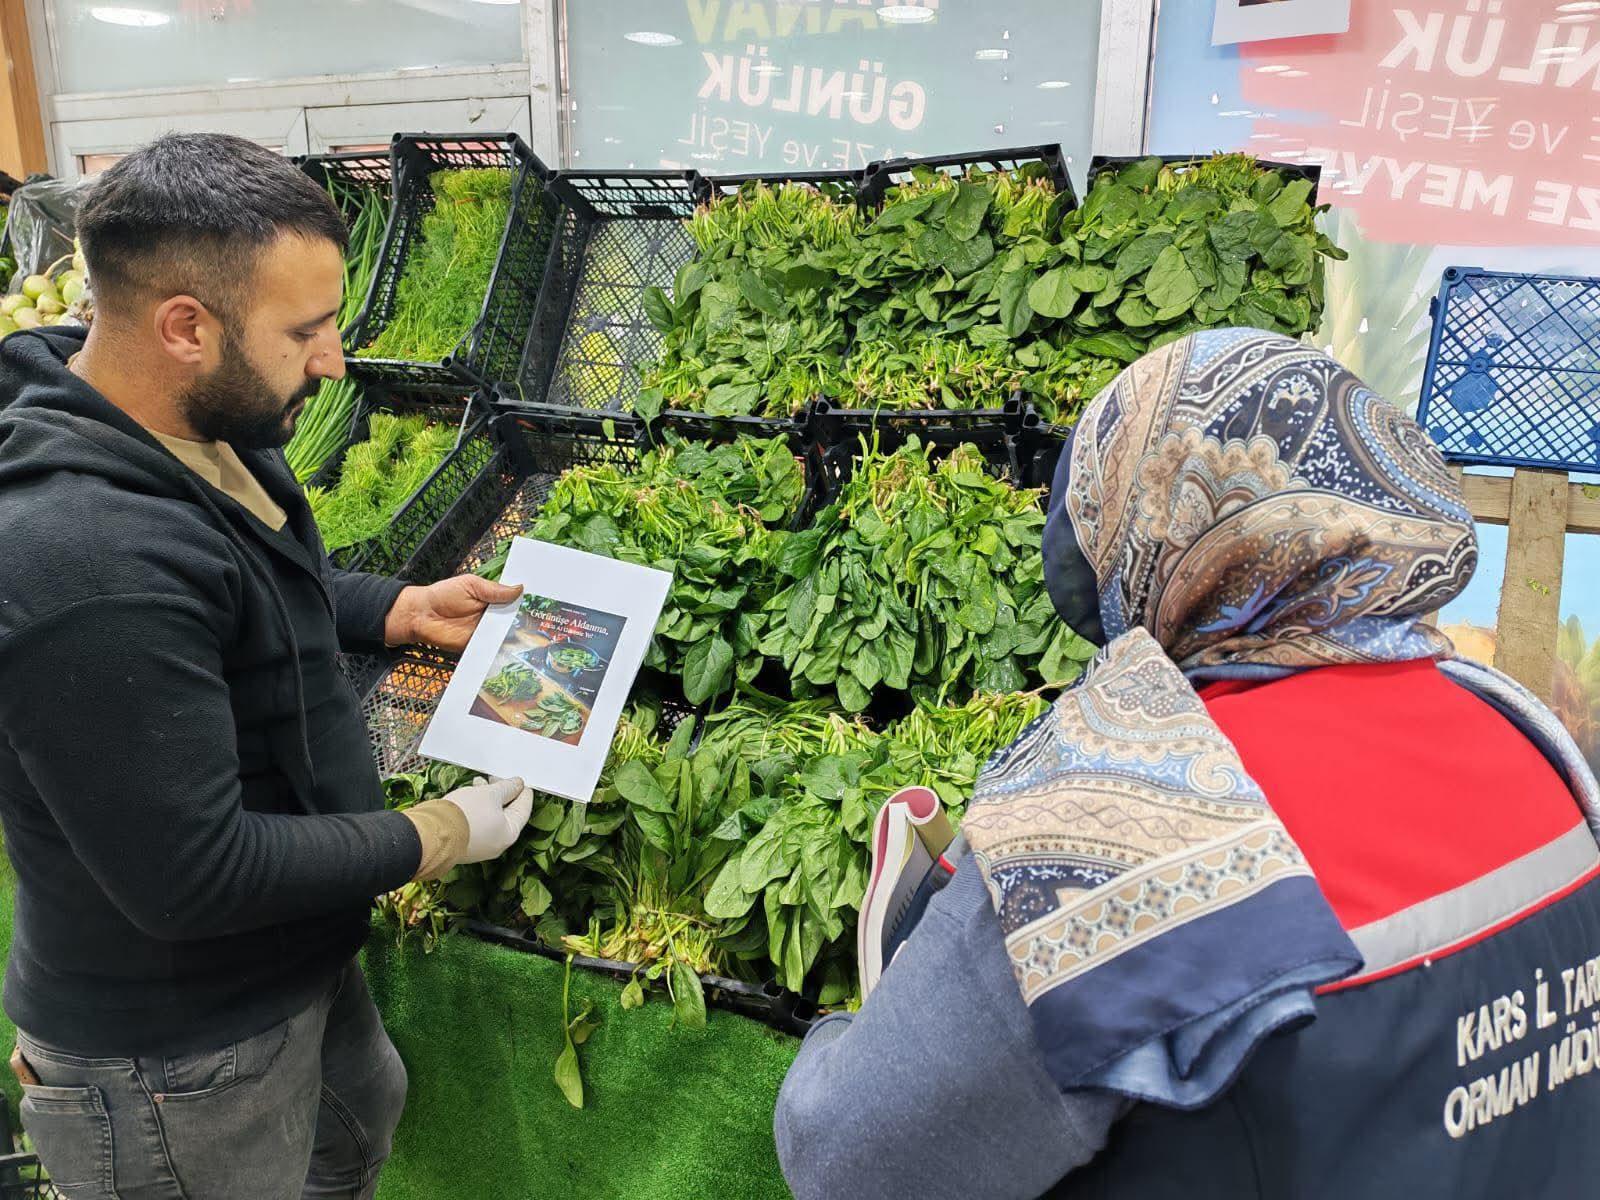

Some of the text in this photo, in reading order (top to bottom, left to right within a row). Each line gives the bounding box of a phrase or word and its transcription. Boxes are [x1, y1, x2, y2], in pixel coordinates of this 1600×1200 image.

[1457, 989, 1527, 1067] KARS
[1535, 967, 1557, 1029] İL
[1444, 1051, 1540, 1138] ORMAN
